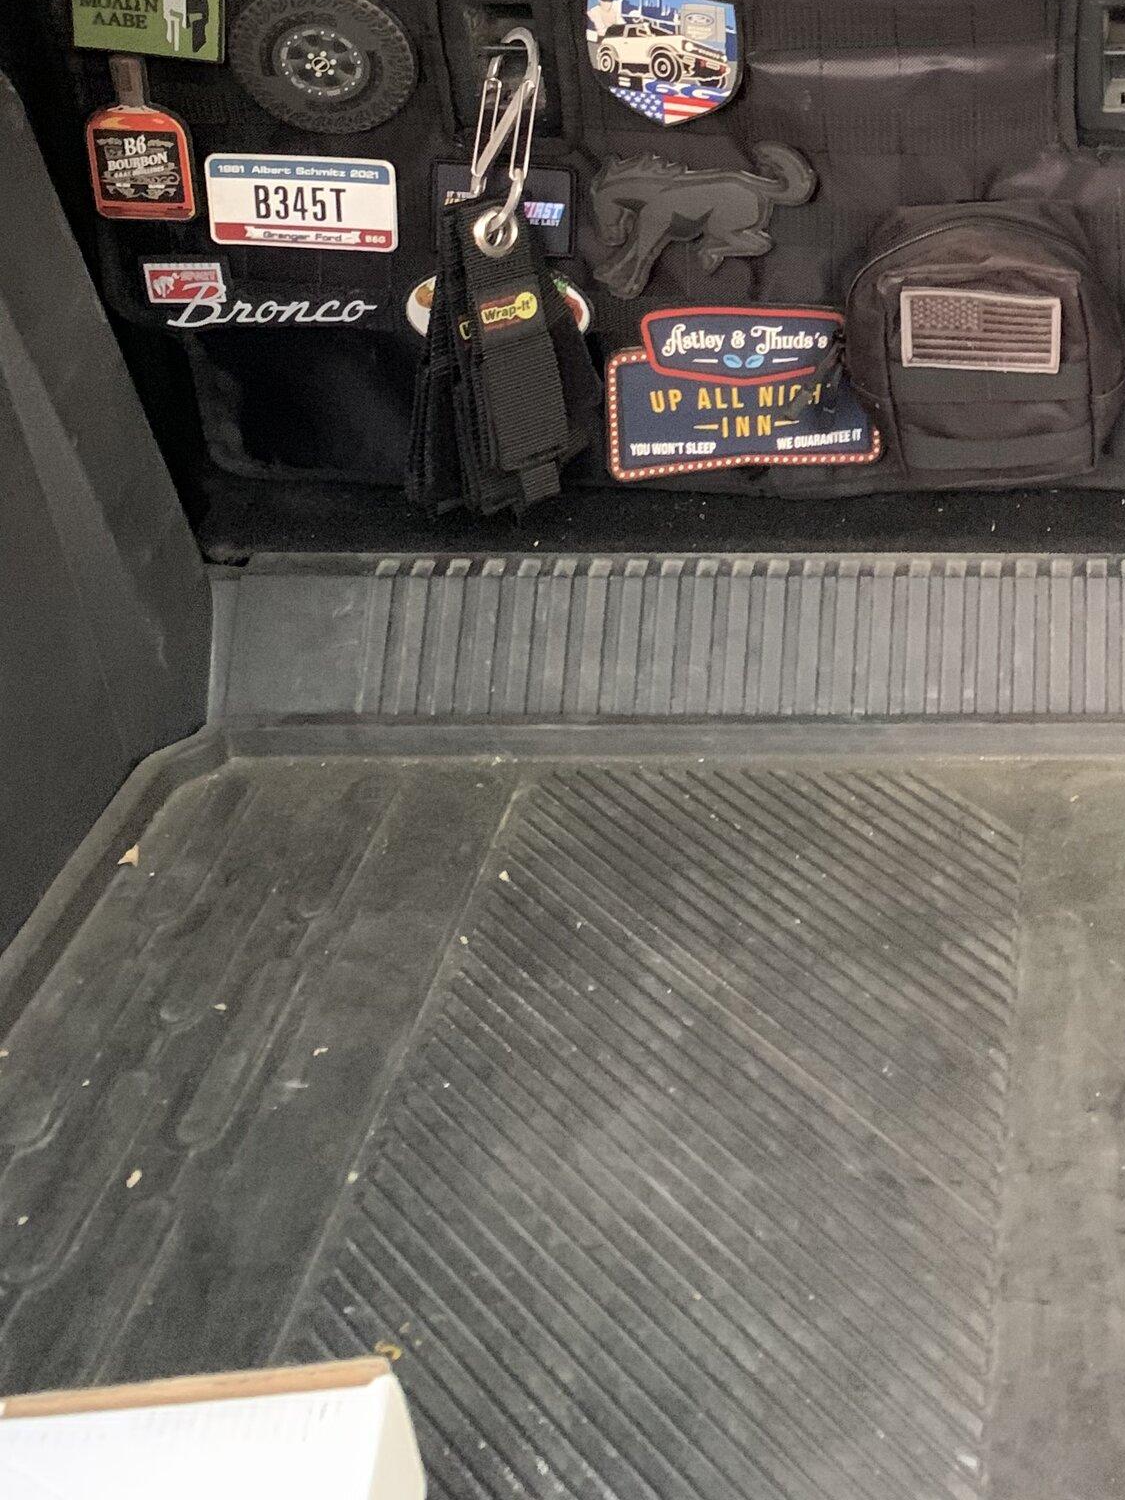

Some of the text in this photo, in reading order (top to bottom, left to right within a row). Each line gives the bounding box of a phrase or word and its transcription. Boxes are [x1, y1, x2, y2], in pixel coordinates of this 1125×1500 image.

[123, 134, 147, 156] B6
[107, 151, 168, 172] BOURBON
[251, 165, 292, 175] Albert
[295, 166, 346, 178] Schmitz
[350, 169, 379, 180] 2021
[254, 185, 346, 223] B345T
[315, 233, 343, 242] Ford
[166, 282, 378, 328] Bronco
[661, 323, 829, 357] Astley & Thuds's
[649, 383, 831, 413] UP ALL NIH
[721, 414, 772, 438] INN
[629, 441, 717, 456] YOU WON'T SLEEP
[776, 428, 862, 451] WE GUARANTEE IT
